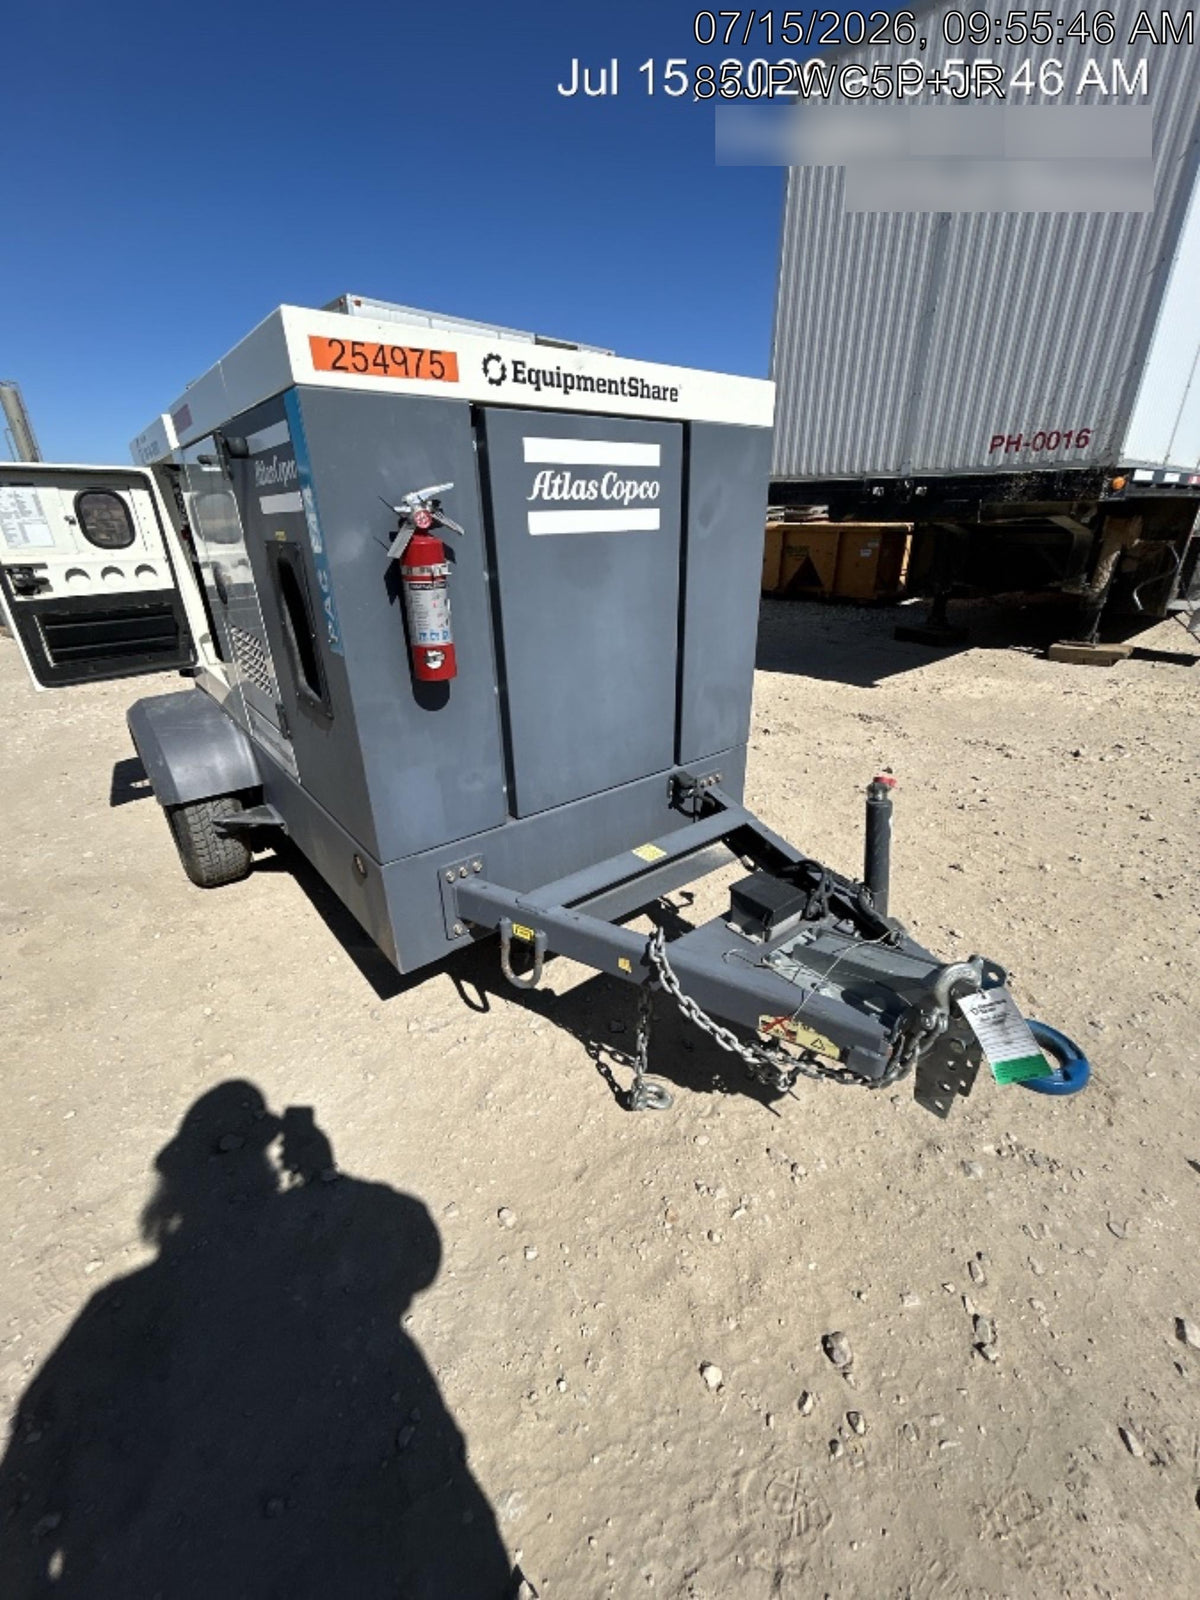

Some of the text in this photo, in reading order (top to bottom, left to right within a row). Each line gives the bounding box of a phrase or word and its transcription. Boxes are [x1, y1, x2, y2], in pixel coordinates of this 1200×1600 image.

[327, 338, 446, 380] 254975
[511, 360, 679, 403] EquipmentShare
[988, 427, 1092, 455] PH-0016
[526, 470, 660, 505] Atlas Copco
